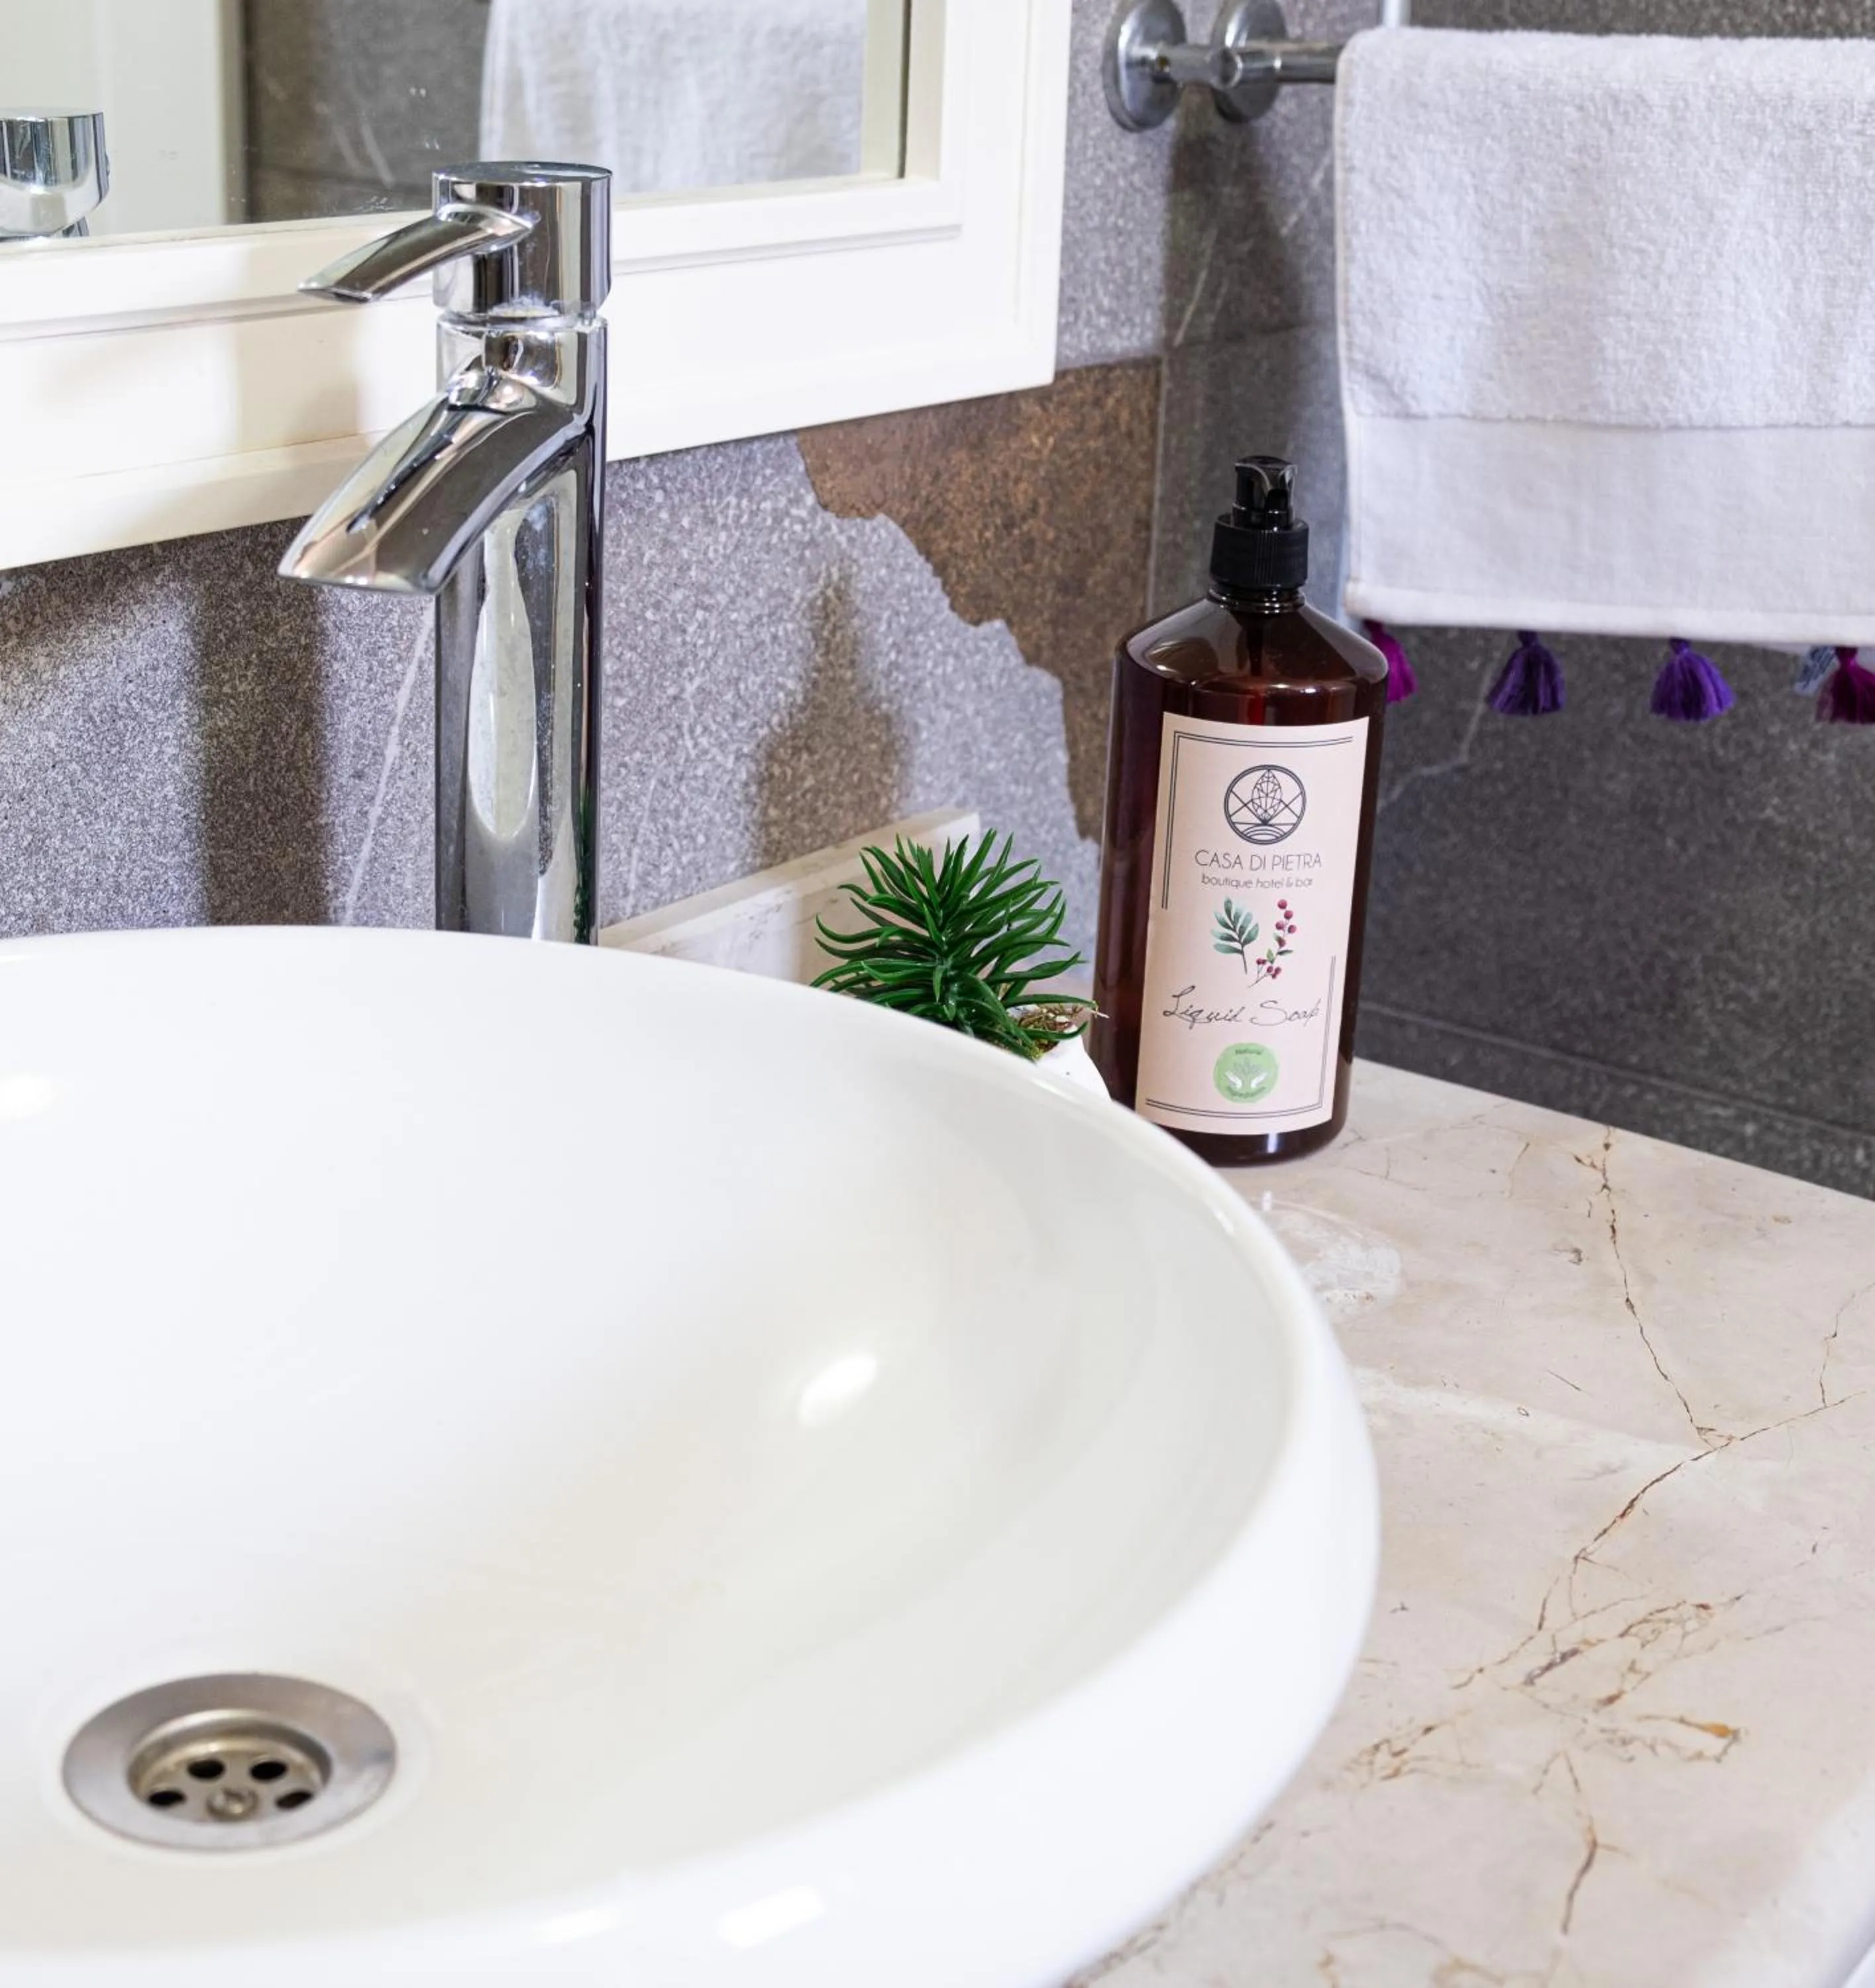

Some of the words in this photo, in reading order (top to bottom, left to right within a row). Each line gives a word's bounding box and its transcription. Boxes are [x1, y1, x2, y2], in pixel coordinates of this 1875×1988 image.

[1195, 849, 1244, 870] CASA
[1250, 854, 1266, 871] DI
[1271, 853, 1322, 871] PIETRA
[1201, 872, 1253, 889] boutique
[1256, 877, 1283, 889] hotel
[1295, 877, 1314, 888] bar
[1162, 985, 1246, 1030] Liquid
[1249, 997, 1322, 1027] Soap
